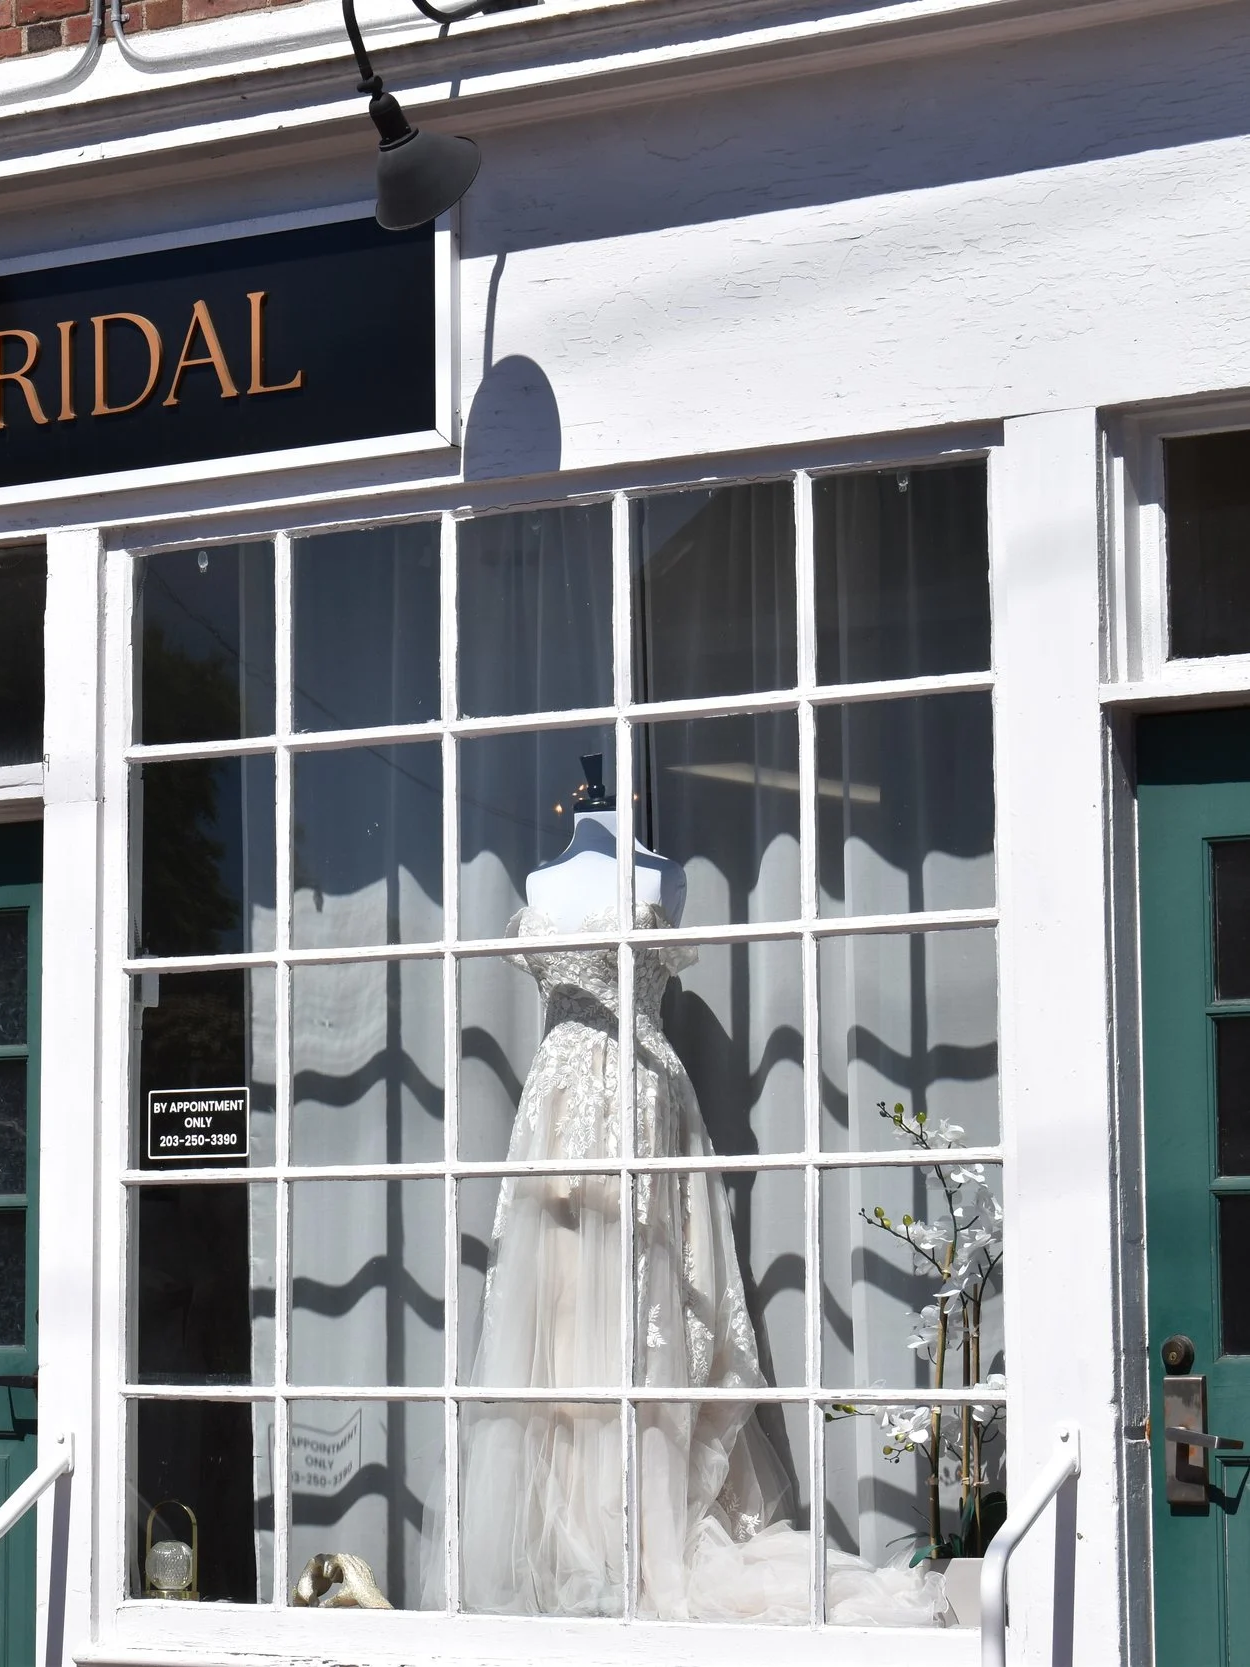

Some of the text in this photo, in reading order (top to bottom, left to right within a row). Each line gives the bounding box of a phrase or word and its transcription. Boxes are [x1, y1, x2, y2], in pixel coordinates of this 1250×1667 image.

[153, 1100, 244, 1113] BY APPOINTMENT
[184, 1117, 213, 1128] ONLY
[159, 1133, 237, 1147] 203-250-3390
[304, 1455, 334, 1470] ONLY
